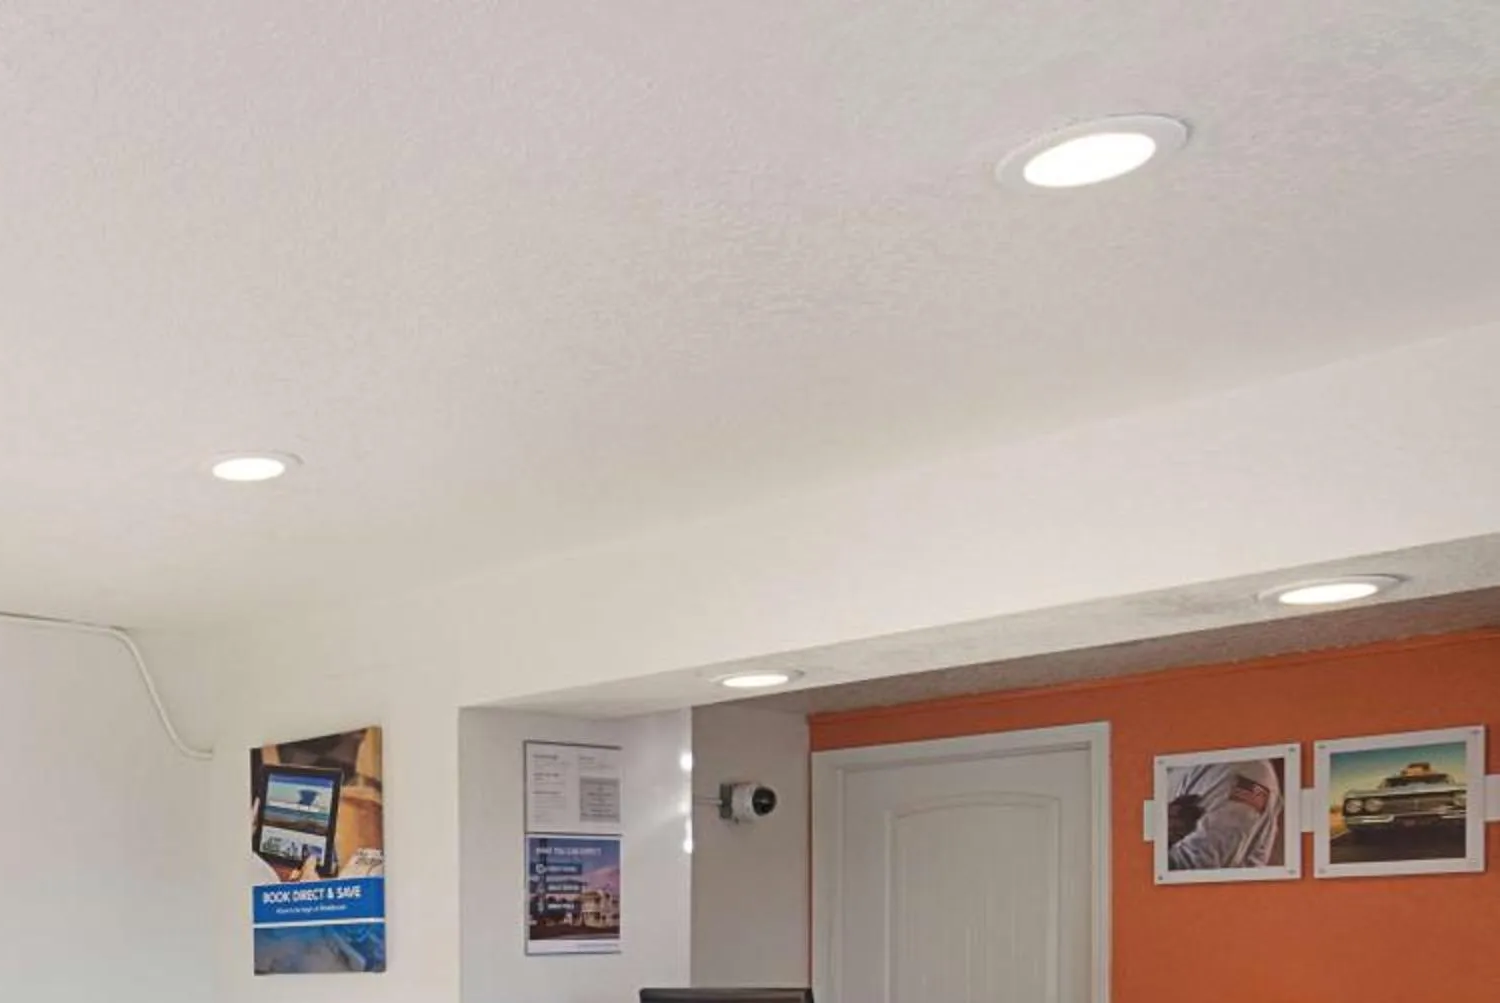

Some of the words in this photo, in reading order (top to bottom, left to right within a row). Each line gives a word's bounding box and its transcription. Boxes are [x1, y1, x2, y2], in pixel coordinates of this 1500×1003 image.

[263, 891, 290, 904] BOOK
[292, 888, 325, 902] DIRECT
[327, 887, 334, 899] &
[336, 885, 361, 899] SAVE
